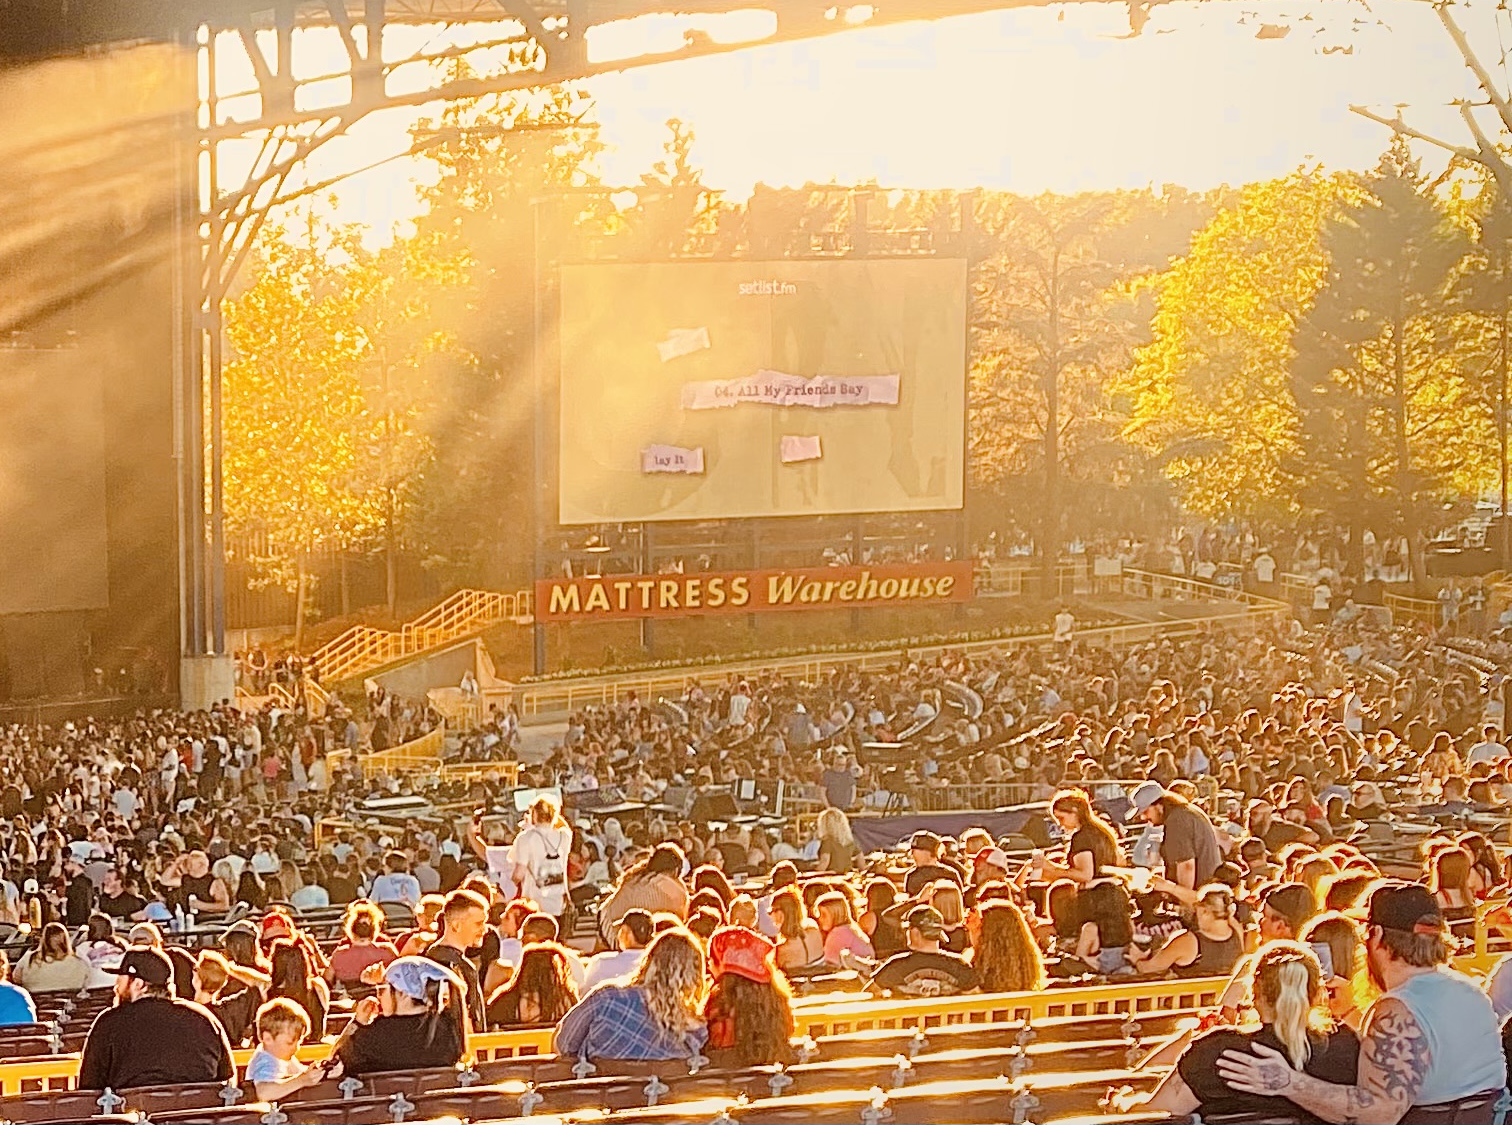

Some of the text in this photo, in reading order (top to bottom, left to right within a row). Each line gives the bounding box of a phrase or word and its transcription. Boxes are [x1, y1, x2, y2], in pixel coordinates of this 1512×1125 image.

[738, 278, 797, 295] setlist.fm
[737, 385, 760, 397] All
[764, 385, 781, 399] My
[785, 383, 836, 396] Friends
[548, 570, 956, 614] MATTRESS Warehouse
